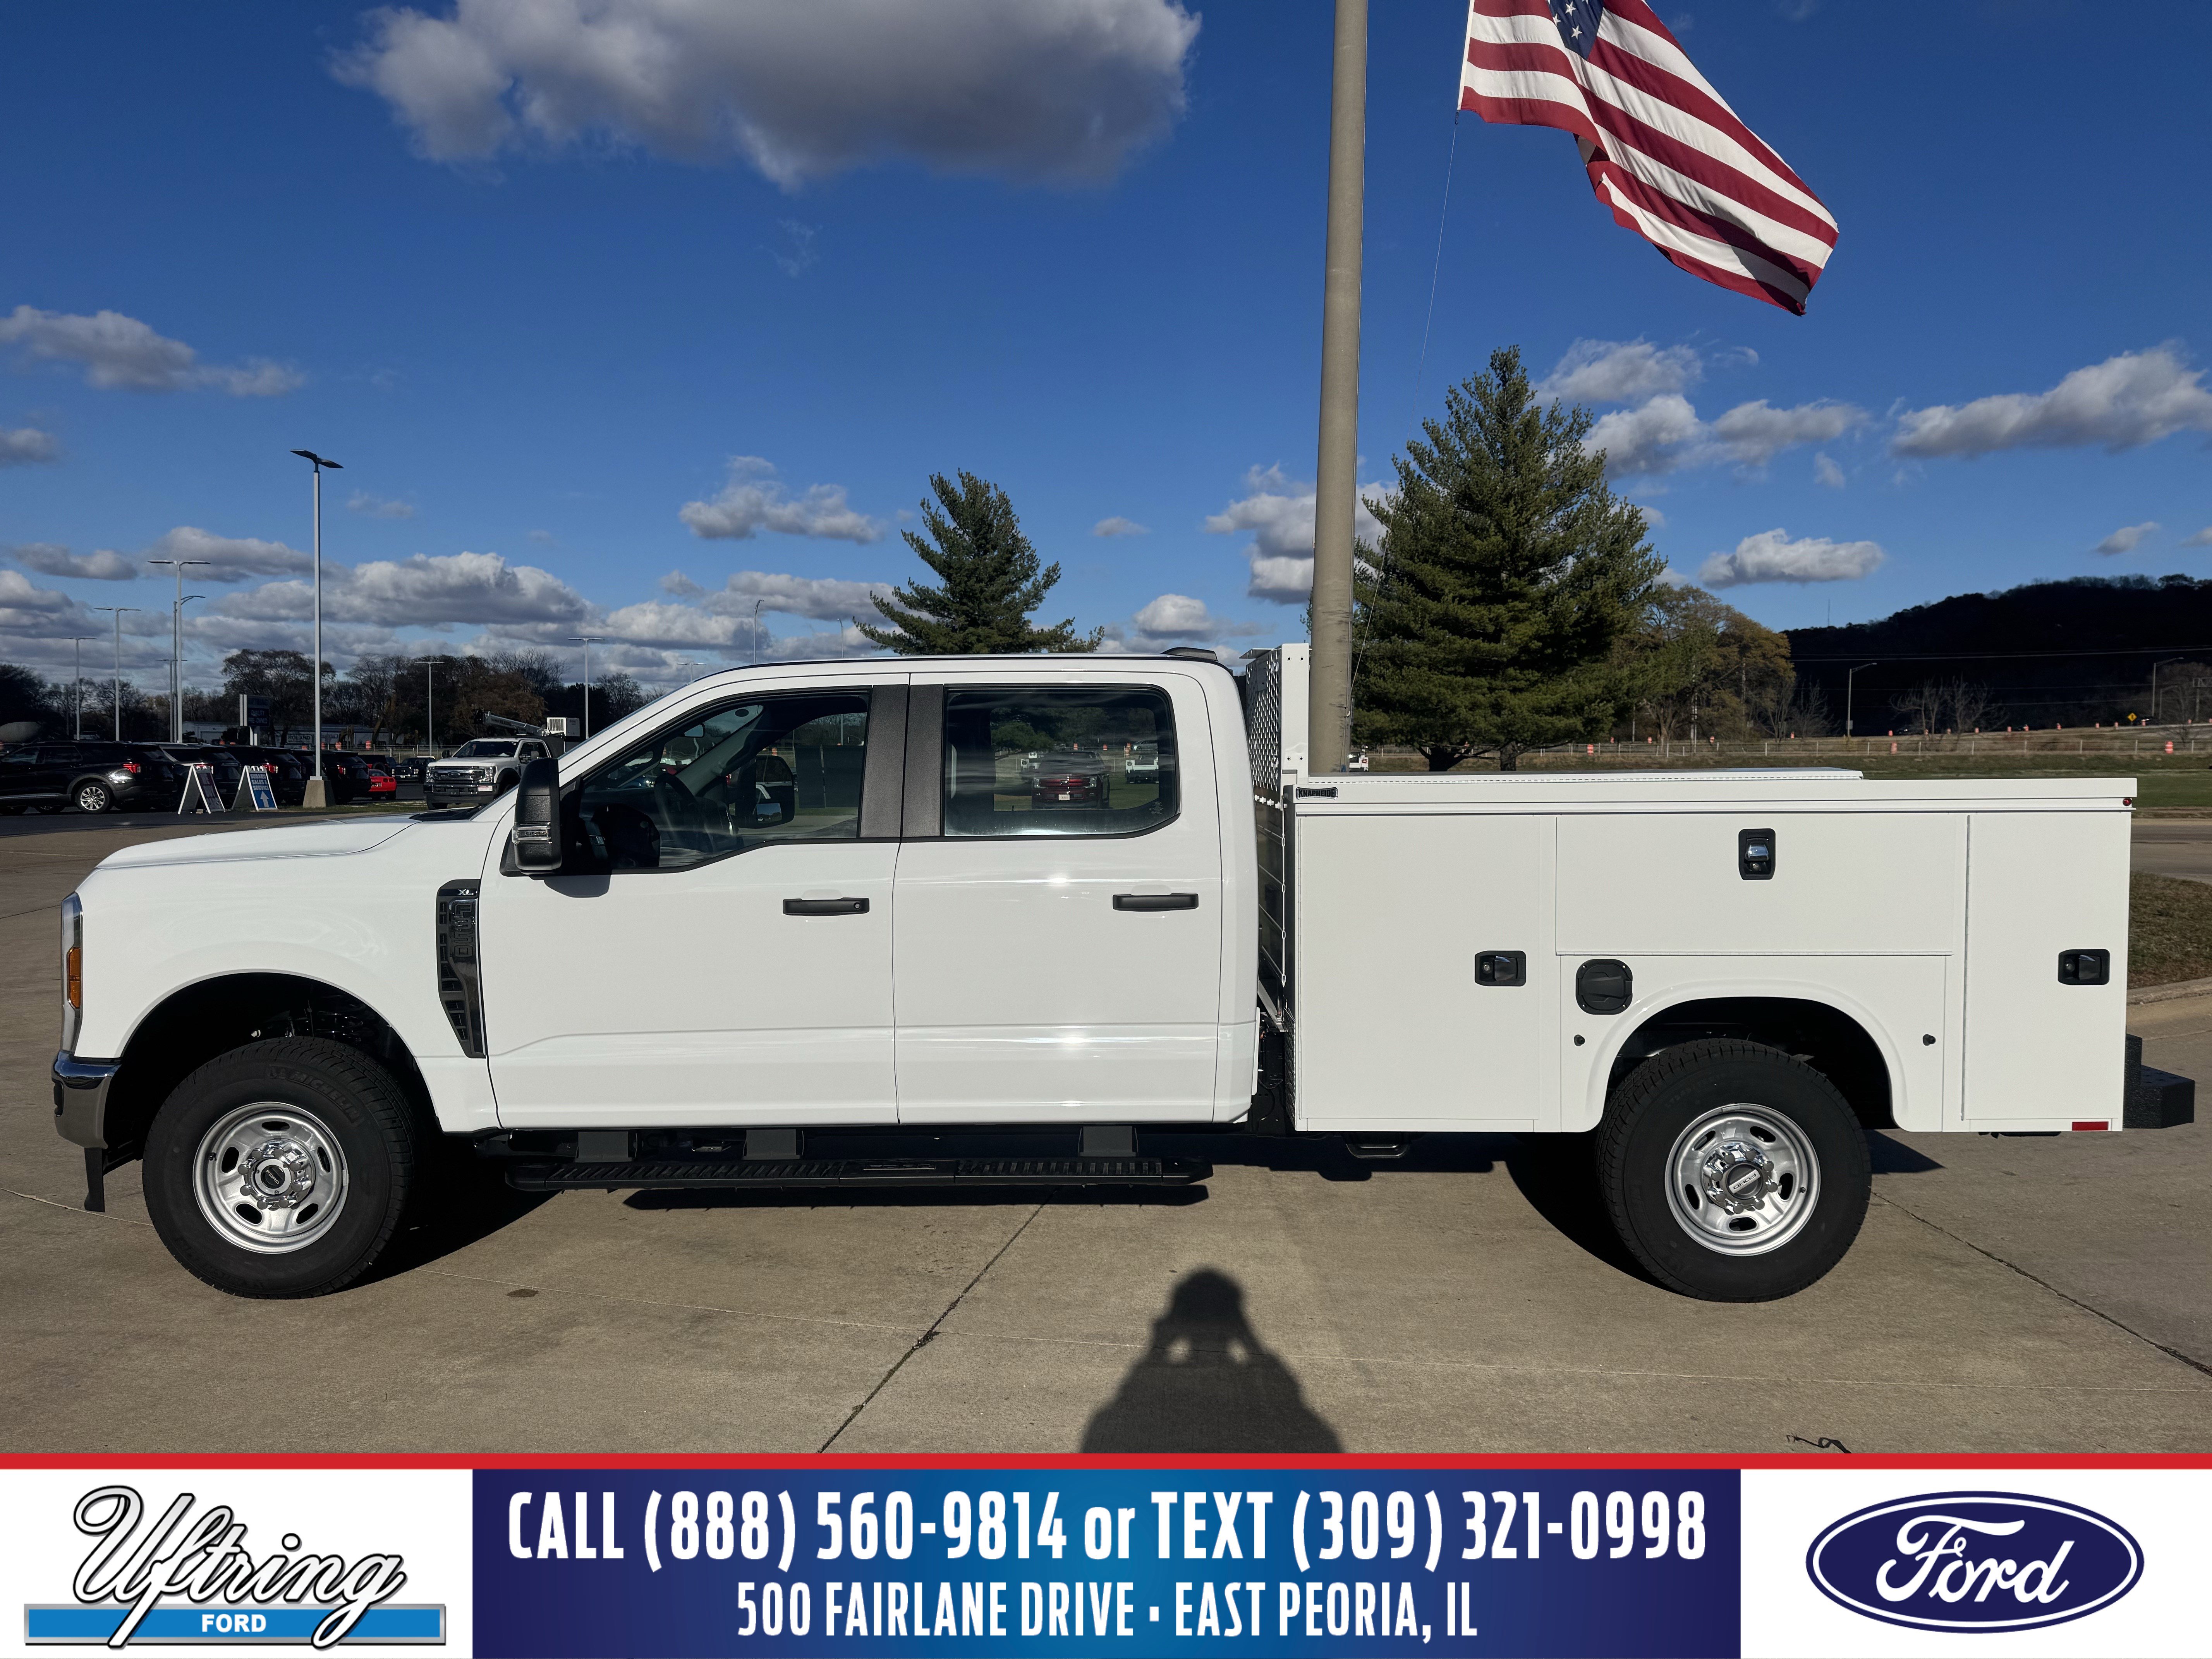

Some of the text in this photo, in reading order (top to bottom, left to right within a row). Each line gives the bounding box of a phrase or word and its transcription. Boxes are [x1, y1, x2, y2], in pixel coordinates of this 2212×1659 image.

[1298, 789, 1335, 798] KNAPHEIDE
[289, 1070, 361, 1124] MICHELIN
[266, 1170, 280, 1184] FORD
[1733, 1173, 1756, 1189] FORD
